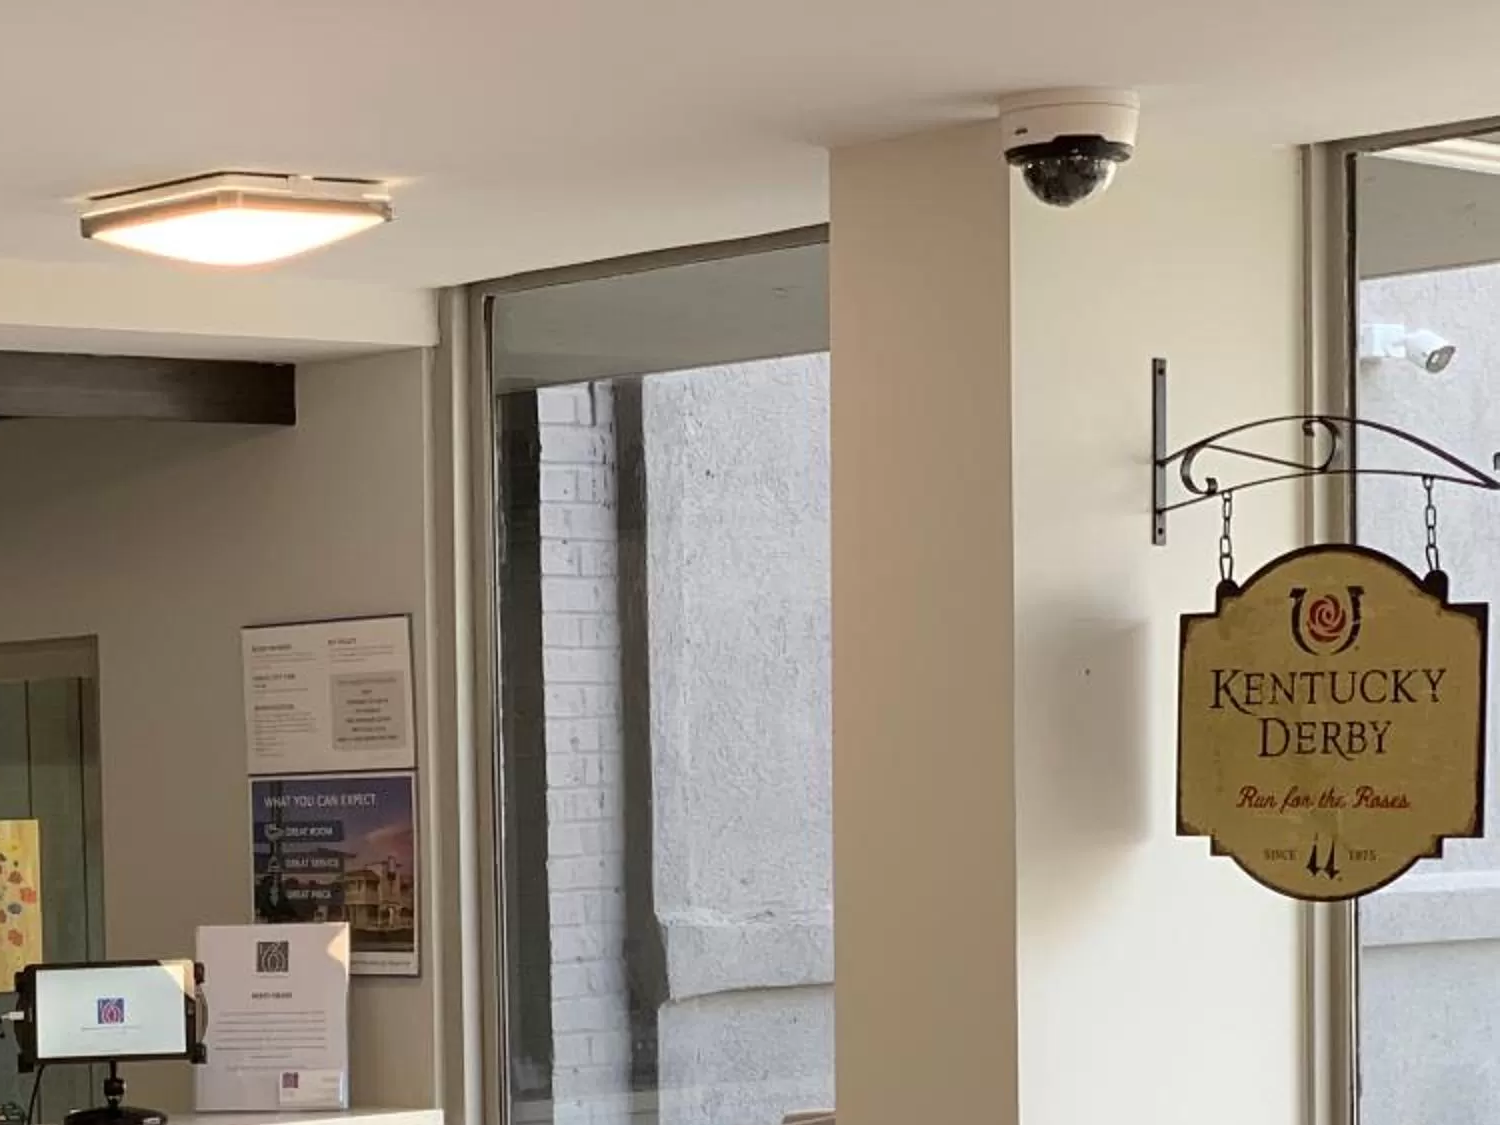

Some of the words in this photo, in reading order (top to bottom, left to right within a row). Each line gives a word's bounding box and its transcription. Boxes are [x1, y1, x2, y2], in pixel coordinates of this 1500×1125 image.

[1209, 667, 1447, 715] KENTUCKY
[1259, 717, 1393, 761] DERBY
[263, 795, 291, 808] WHAT
[293, 794, 315, 808] YOU
[317, 794, 338, 808] CAN
[1235, 785, 1278, 809] Run
[1280, 785, 1314, 815] for
[1315, 786, 1348, 809] the
[1351, 785, 1412, 809] Roses
